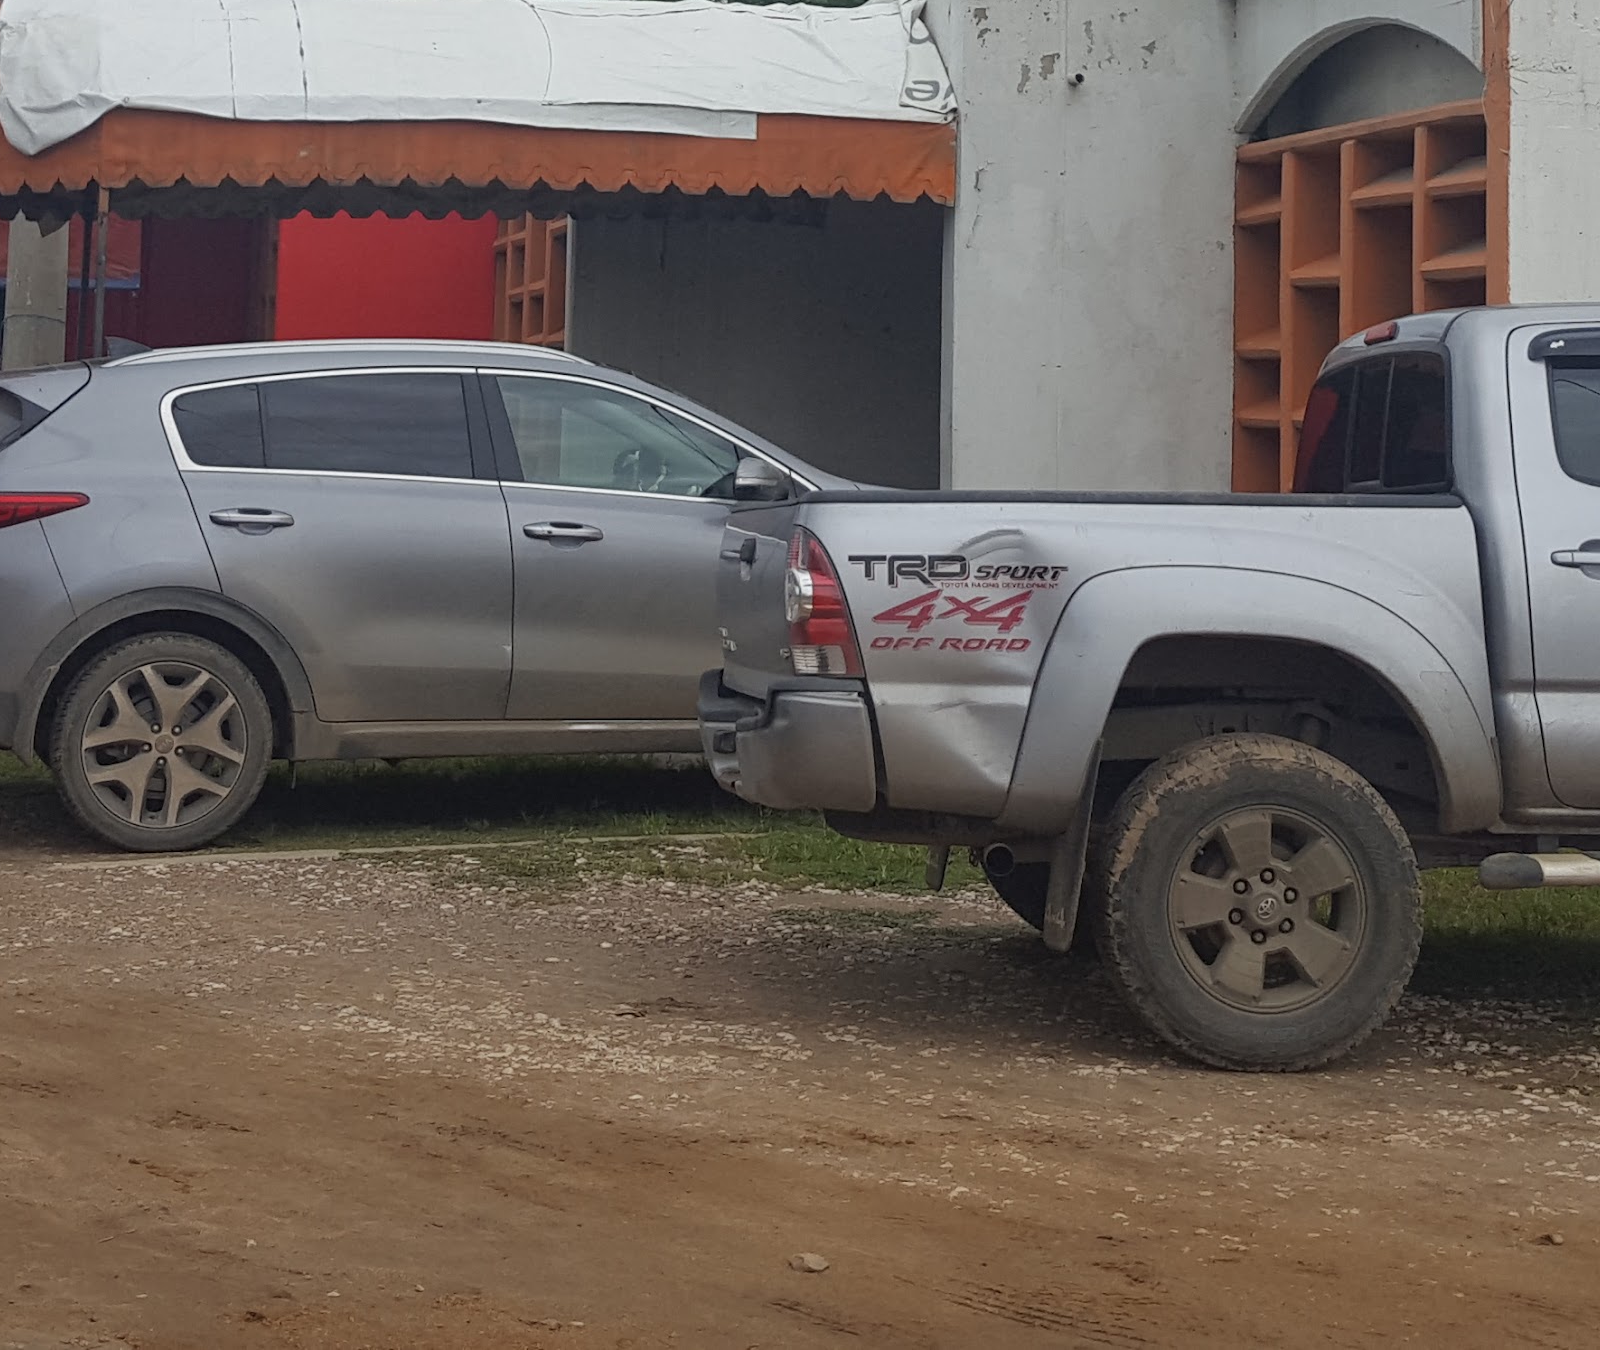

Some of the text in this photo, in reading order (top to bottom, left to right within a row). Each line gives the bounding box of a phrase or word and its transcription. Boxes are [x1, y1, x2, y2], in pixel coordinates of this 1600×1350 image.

[848, 555, 1069, 589] TRD SPORT
[870, 637, 1032, 652] OFF ROAD
